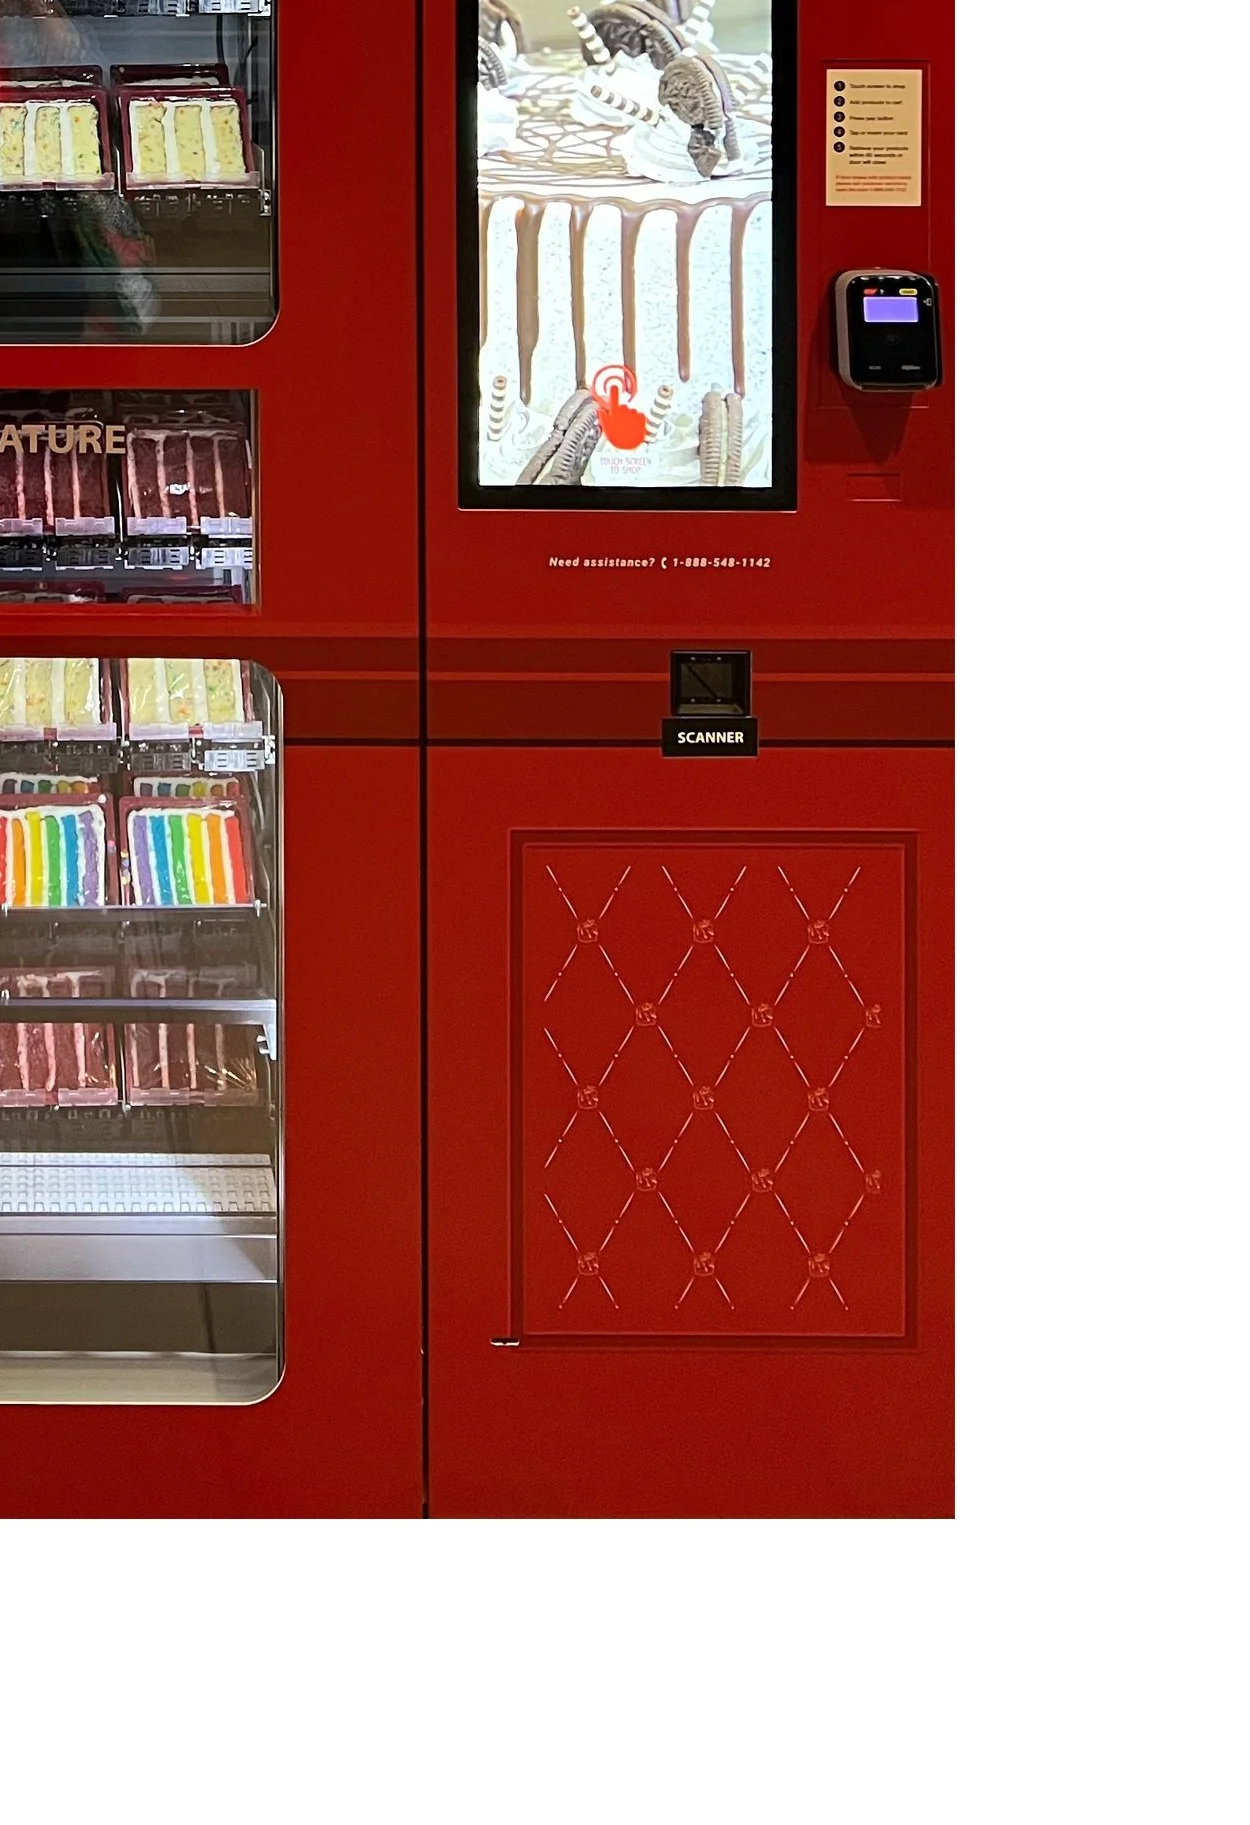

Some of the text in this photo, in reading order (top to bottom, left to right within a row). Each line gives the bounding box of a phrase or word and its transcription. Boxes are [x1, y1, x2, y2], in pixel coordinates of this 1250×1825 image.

[549, 556, 772, 568] Need assistance? 1-888-548-1142
[677, 732, 744, 743] SCANNER
